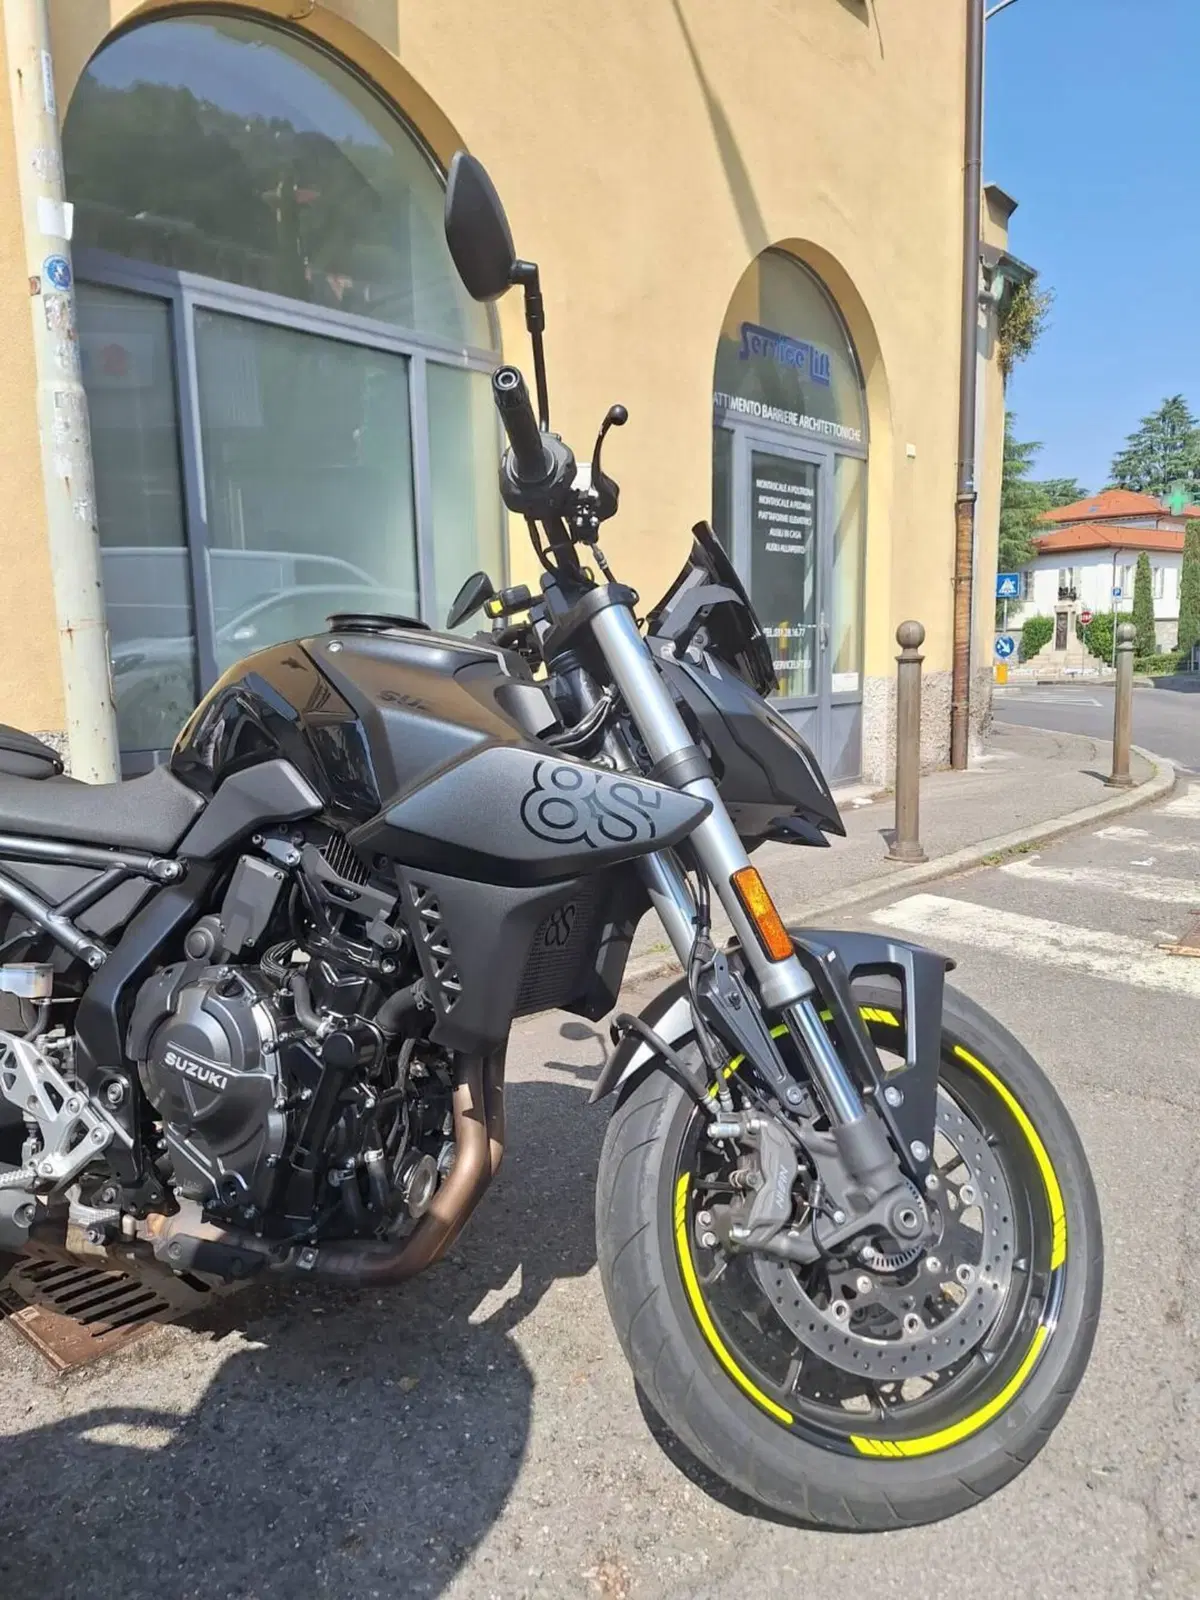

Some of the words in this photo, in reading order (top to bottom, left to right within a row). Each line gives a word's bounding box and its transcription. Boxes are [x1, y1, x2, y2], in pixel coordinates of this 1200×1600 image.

[761, 403, 799, 427] BARRIERE
[798, 414, 862, 442] ARCHITETTONICHE
[164, 1051, 228, 1090] SUZUKI
